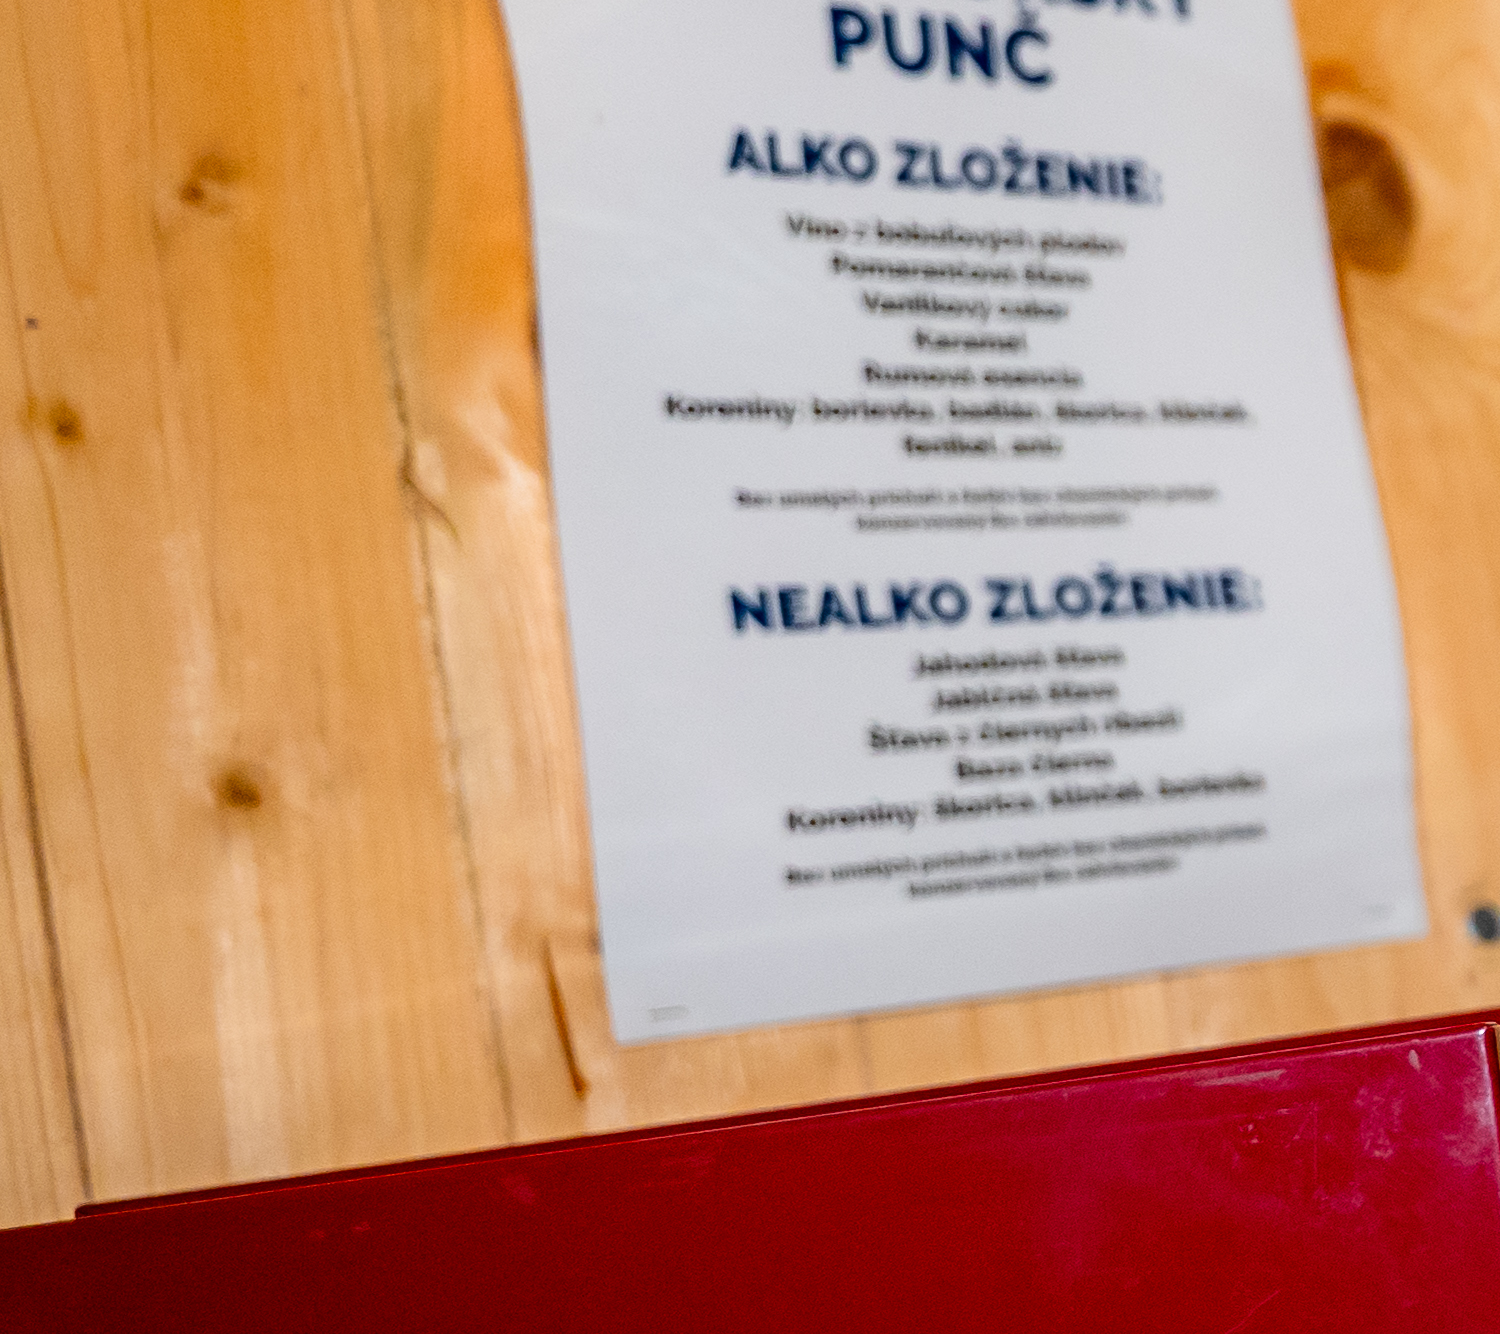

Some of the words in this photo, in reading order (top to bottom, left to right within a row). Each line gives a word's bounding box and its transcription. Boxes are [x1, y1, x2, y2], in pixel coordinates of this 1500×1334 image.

[829, 4, 1055, 88] PUNČ
[725, 128, 879, 184] ALKO
[894, 141, 1163, 205] ZLOŽENIE:
[728, 579, 971, 634] NEALKO
[984, 564, 1263, 624] ZLOŽENIE:
